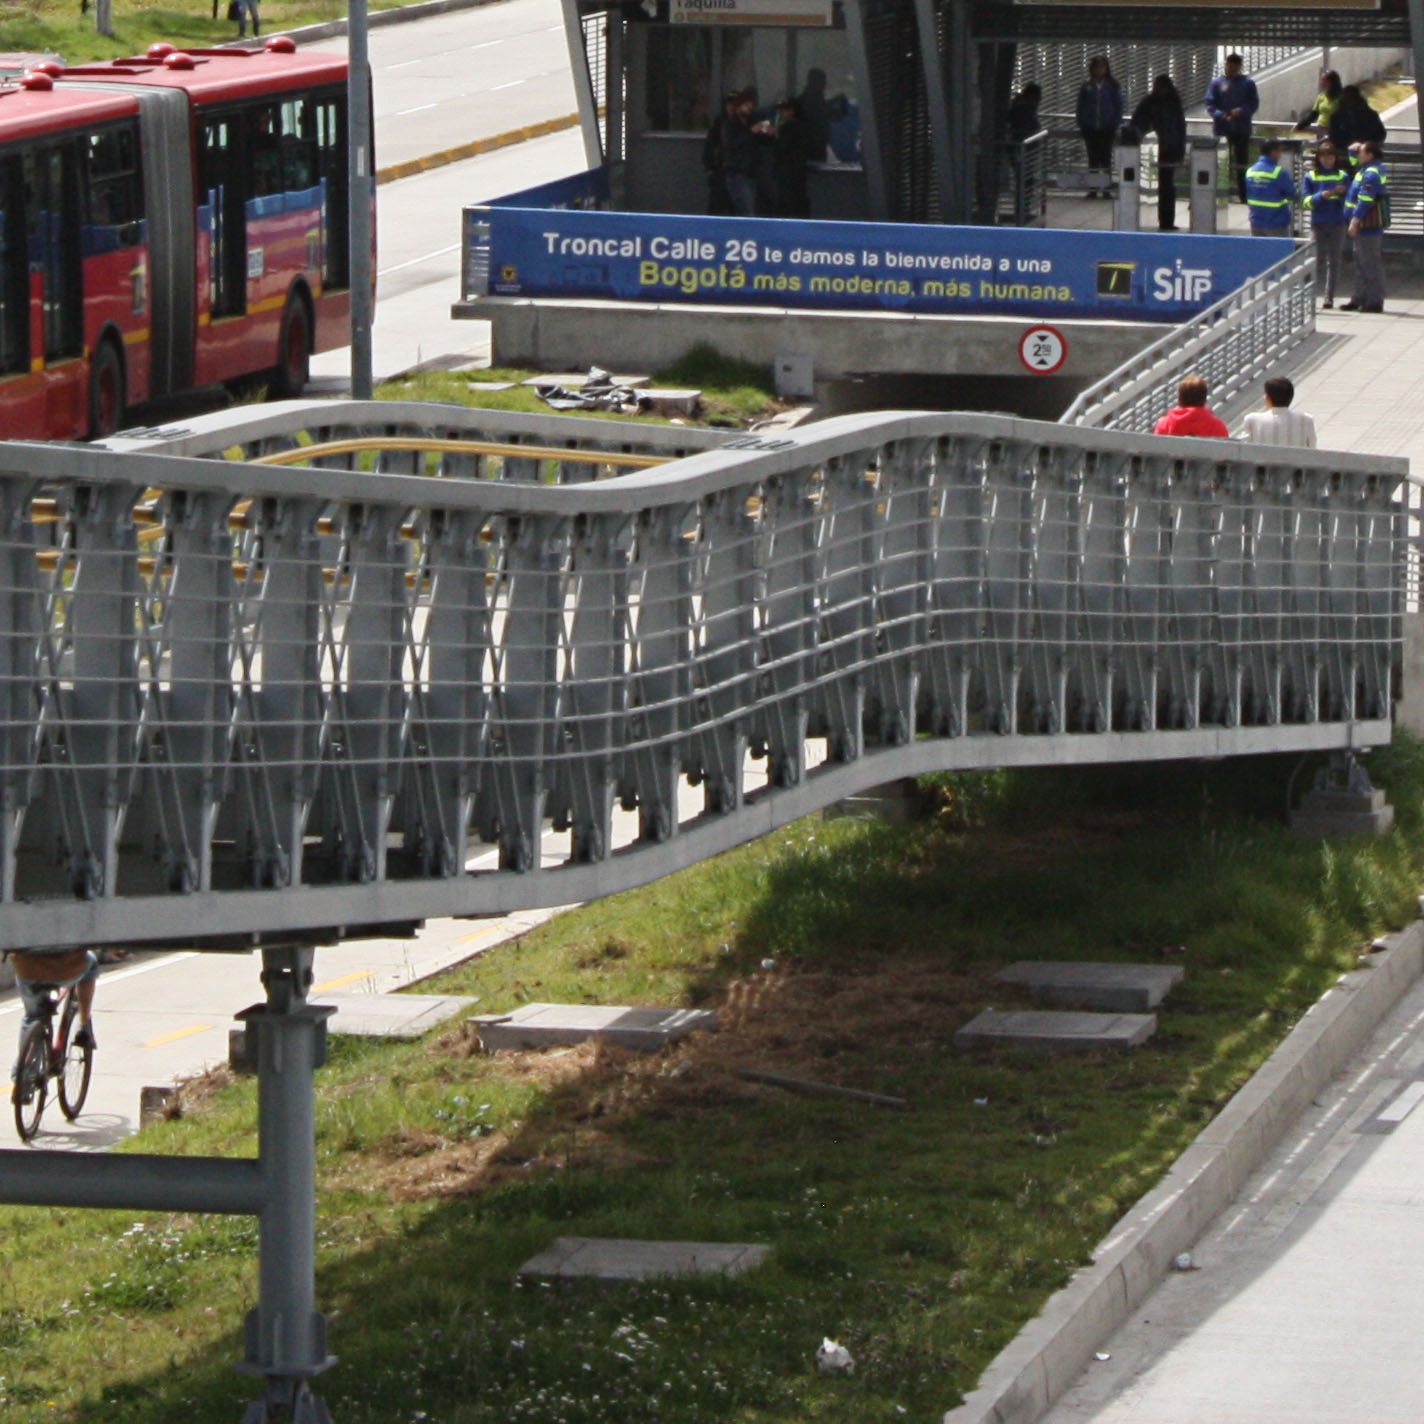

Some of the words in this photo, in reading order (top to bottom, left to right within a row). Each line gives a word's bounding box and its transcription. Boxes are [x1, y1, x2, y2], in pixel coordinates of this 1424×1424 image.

[542, 232, 642, 258] Troncal
[650, 236, 716, 260] Calle
[725, 239, 758, 262] 26
[764, 246, 783, 264] te
[789, 247, 856, 266] damos
[862, 249, 879, 267] la
[885, 251, 993, 272] bienvenida
[998, 257, 1011, 272] a
[1016, 257, 1052, 273] una
[639, 260, 746, 294] Bogotá
[753, 273, 802, 292] más
[809, 274, 916, 297] moderna,
[922, 278, 972, 299] más
[979, 279, 1075, 302] humana.
